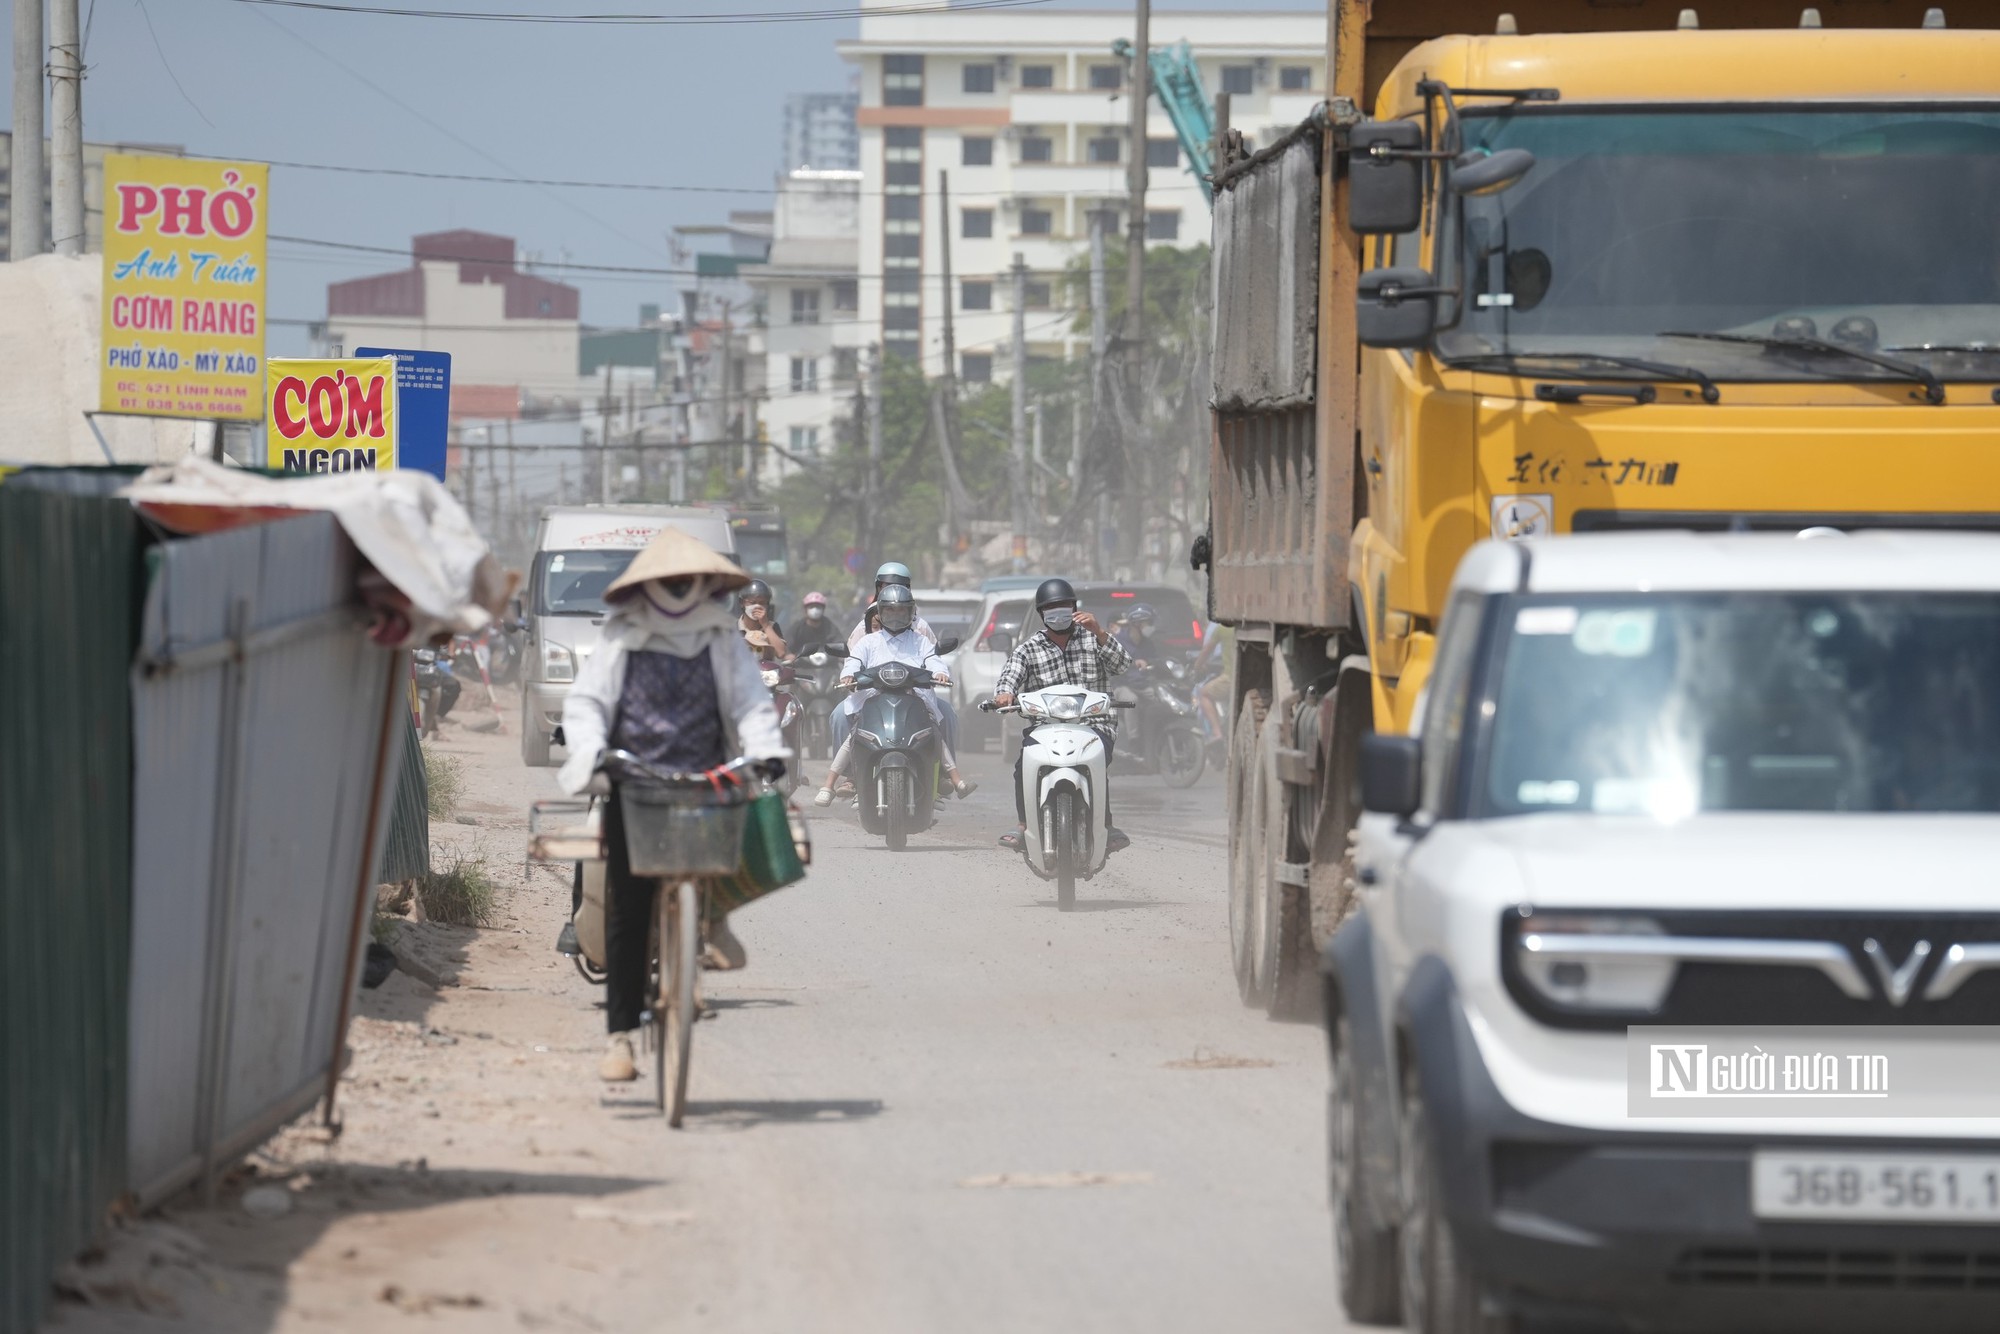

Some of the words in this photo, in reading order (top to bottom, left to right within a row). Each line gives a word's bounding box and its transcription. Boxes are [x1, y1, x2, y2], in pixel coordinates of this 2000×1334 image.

[117, 171, 256, 237] PHỞ
[114, 249, 178, 280] Anh
[190, 252, 257, 283] Tuấn
[113, 295, 173, 332] CƠM
[183, 300, 256, 336] RANG
[109, 343, 142, 368] PHỞ
[147, 348, 179, 371] XÀO
[224, 353, 257, 375] XÀO
[273, 369, 386, 439] CƠM
[283, 448, 376, 475] NGON
